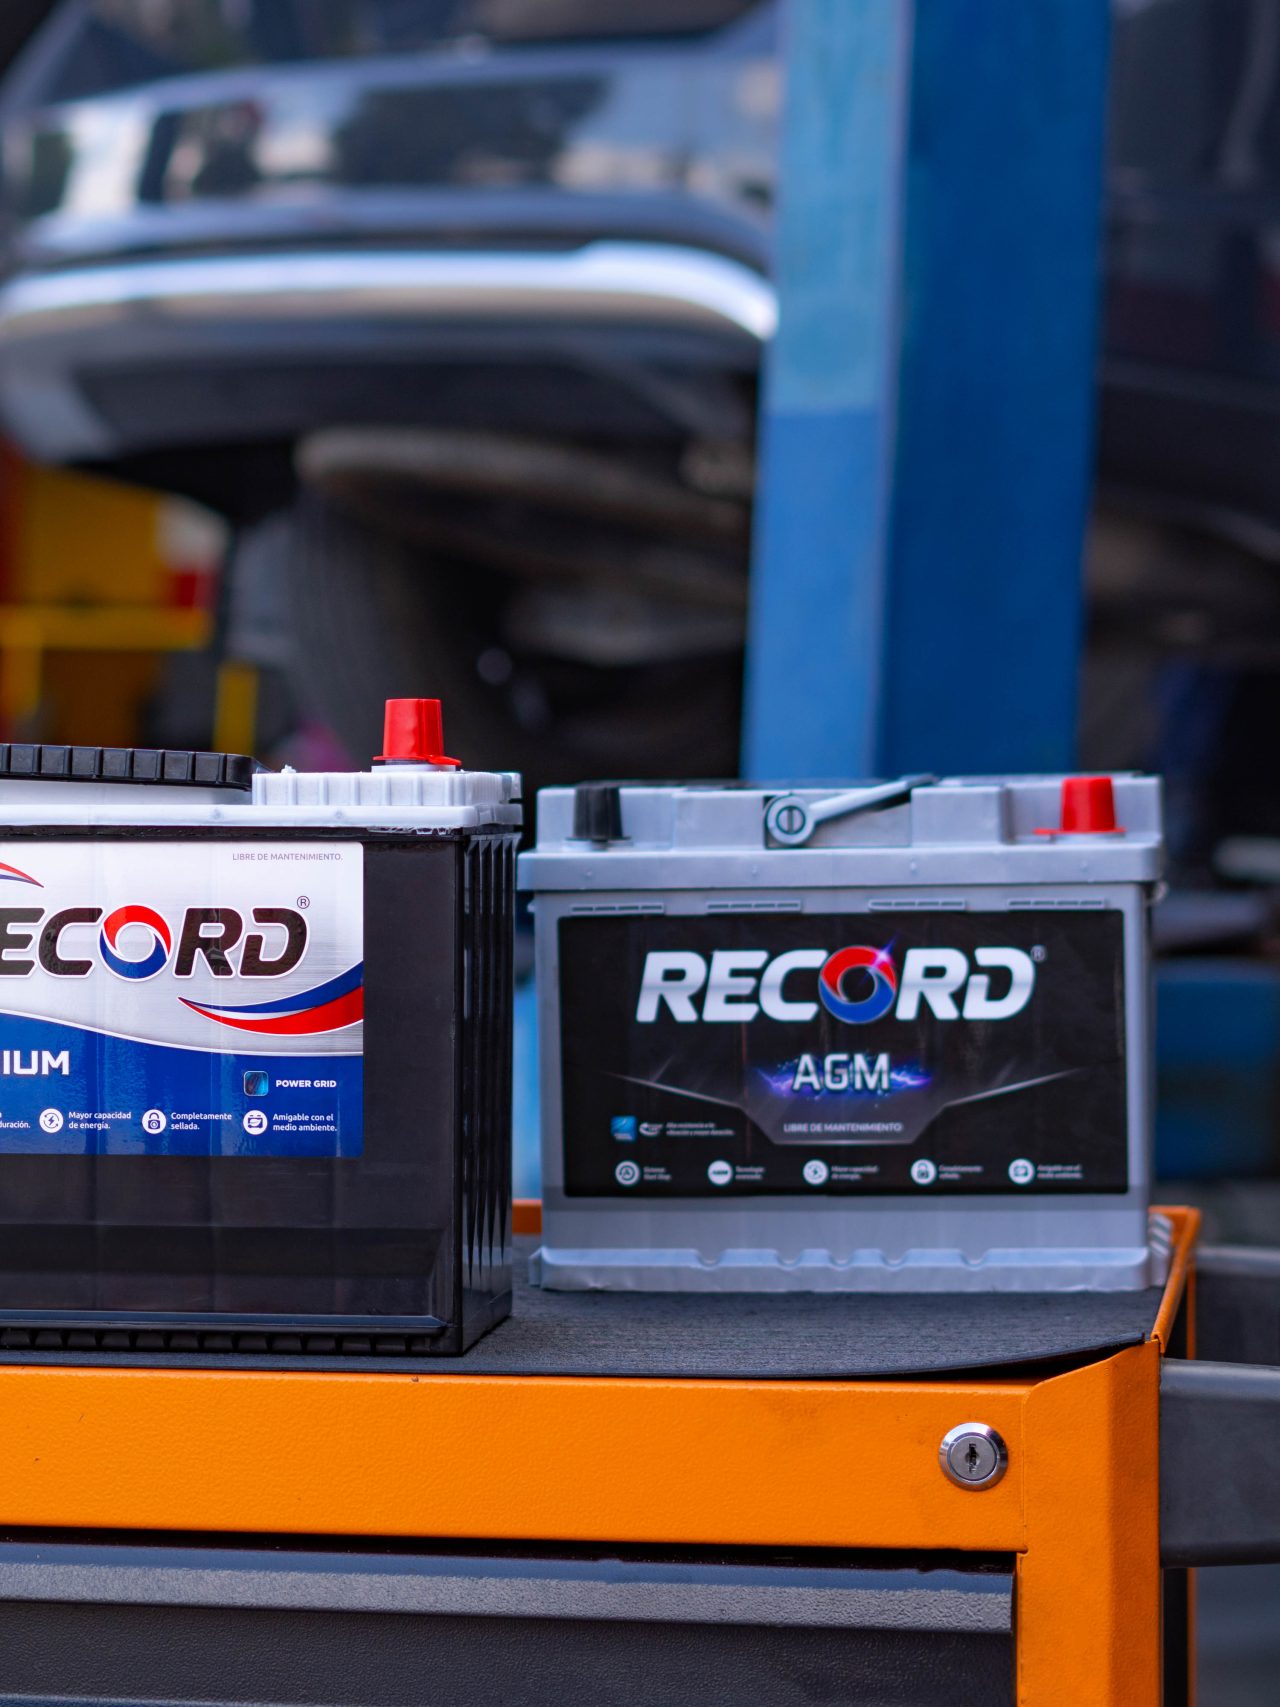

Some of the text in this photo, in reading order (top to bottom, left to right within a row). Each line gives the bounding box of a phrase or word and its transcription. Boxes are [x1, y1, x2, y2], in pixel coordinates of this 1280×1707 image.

[232, 853, 255, 861] LIBRE
[257, 853, 268, 861] DE
[792, 1053, 890, 1090] AGM
[275, 1080, 337, 1088] POWER GRID
[68, 1111, 132, 1122] Mayor capacidad
[171, 1112, 232, 1121] Completamente
[272, 1113, 309, 1122] Amigable
[326, 1113, 334, 1121] el
[171, 1122, 200, 1130] sellada.
[273, 1123, 338, 1132] medio ambiente.
[783, 1123, 808, 1133] LIBRE
[810, 1123, 822, 1133] DE
